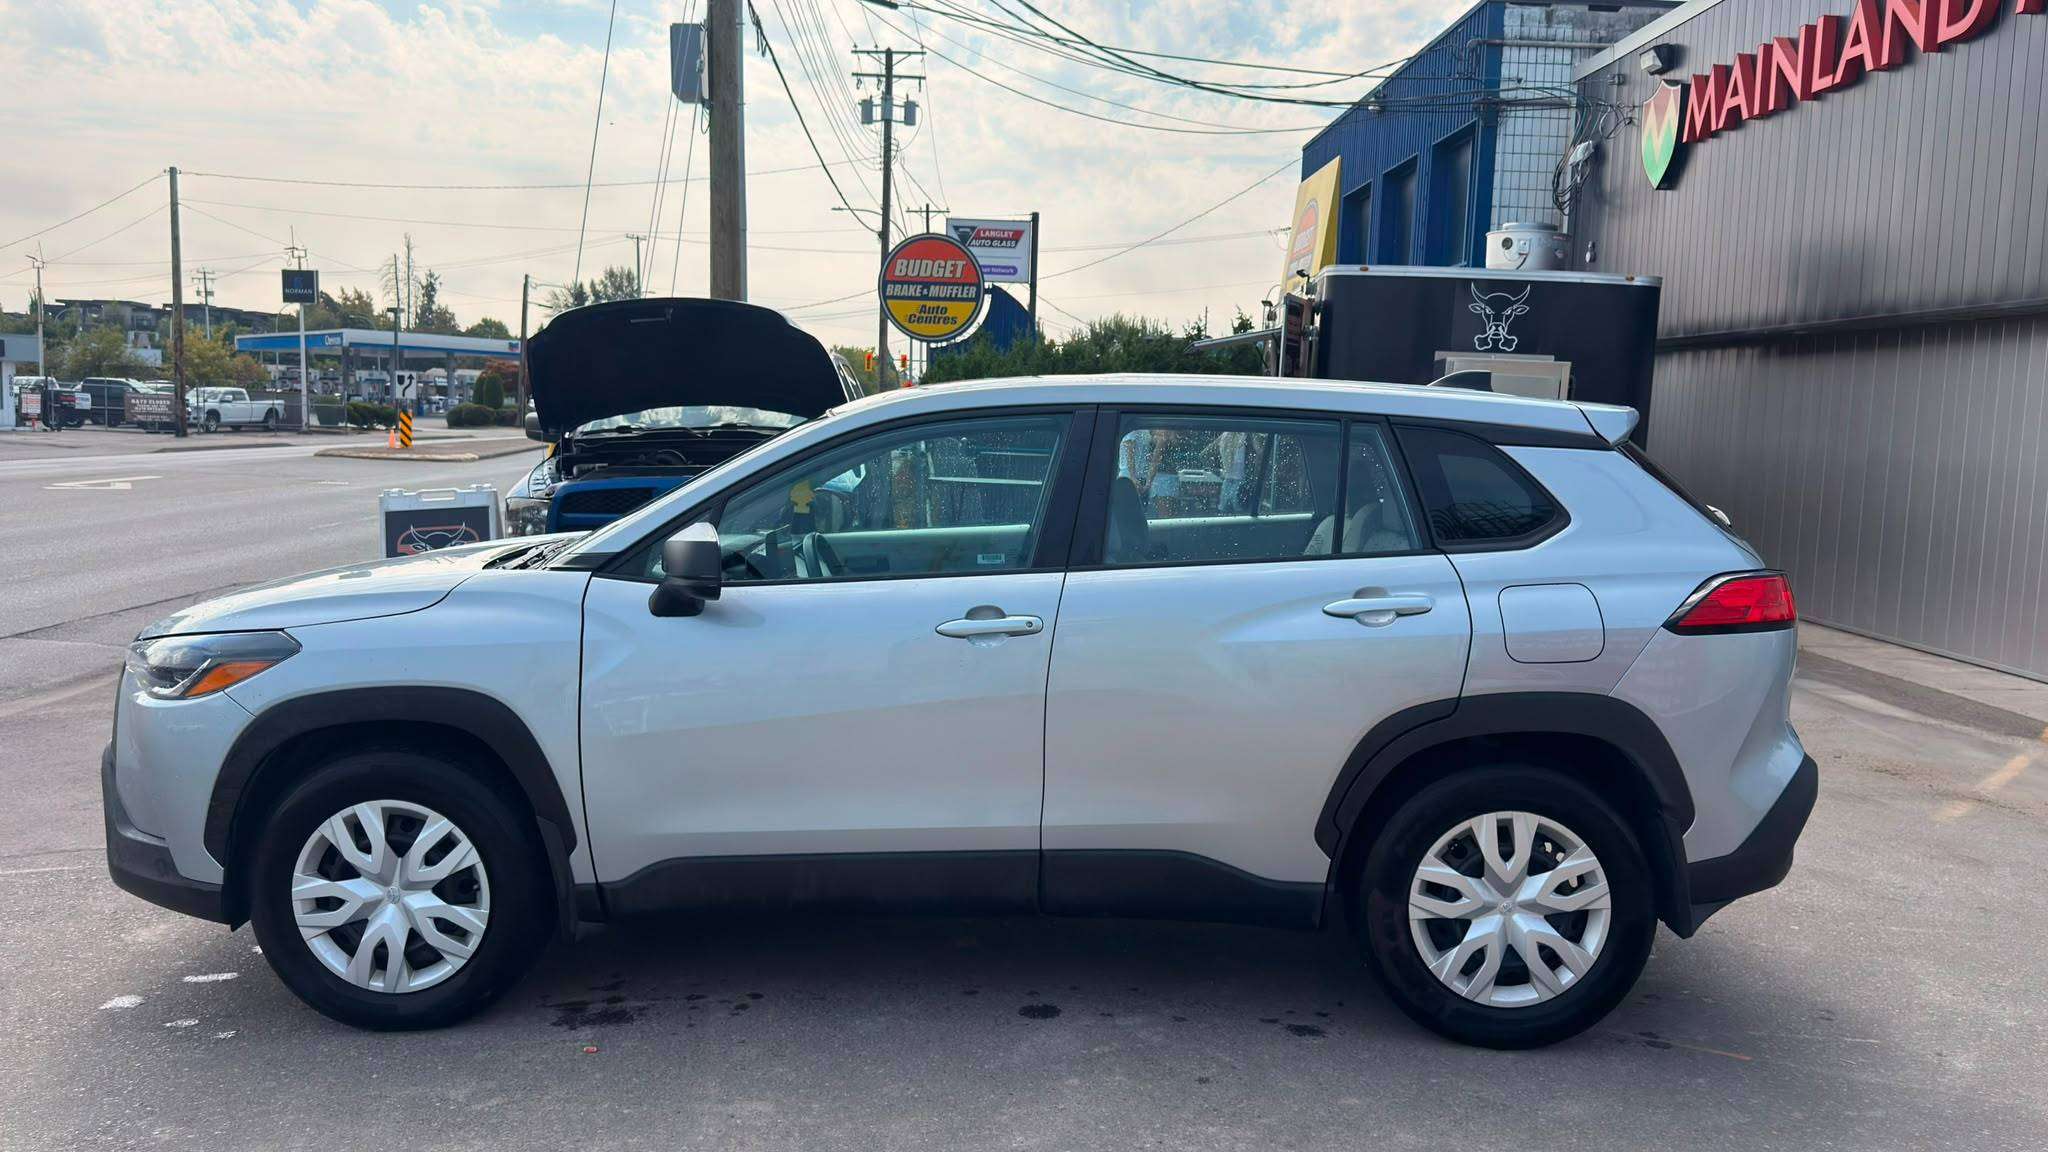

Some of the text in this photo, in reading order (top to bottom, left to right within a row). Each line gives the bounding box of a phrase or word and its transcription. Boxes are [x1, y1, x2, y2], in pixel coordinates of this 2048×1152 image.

[1682, 0, 2003, 143] MAINLAND
[980, 230, 1014, 238] LANGLEY
[970, 239, 991, 247] AUTO
[894, 258, 967, 278] BUDGET
[886, 284, 923, 297] BRAKE
[929, 285, 977, 298] MUFFLER
[919, 304, 948, 315] Auto
[908, 313, 958, 325] Centres
